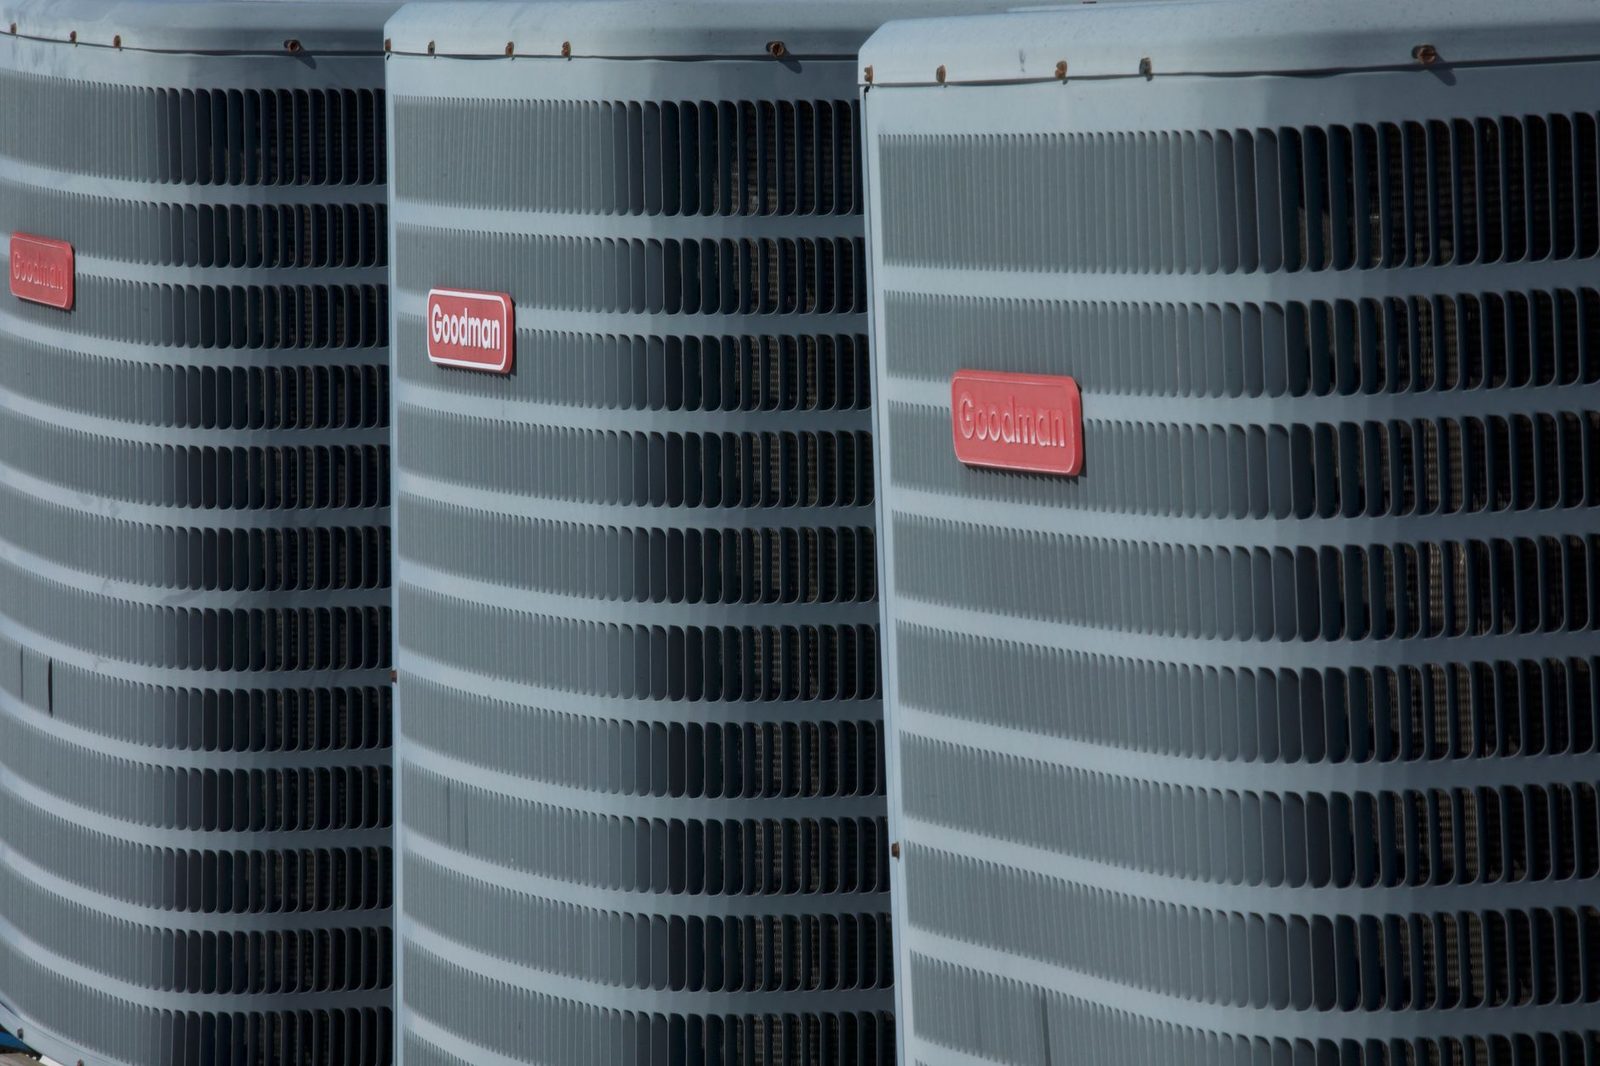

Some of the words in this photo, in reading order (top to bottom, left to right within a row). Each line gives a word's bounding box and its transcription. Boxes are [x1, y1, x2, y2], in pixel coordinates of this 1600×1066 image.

[12, 251, 64, 290] Goodman
[432, 303, 500, 350] Goodman
[959, 392, 1065, 447] Goodman
